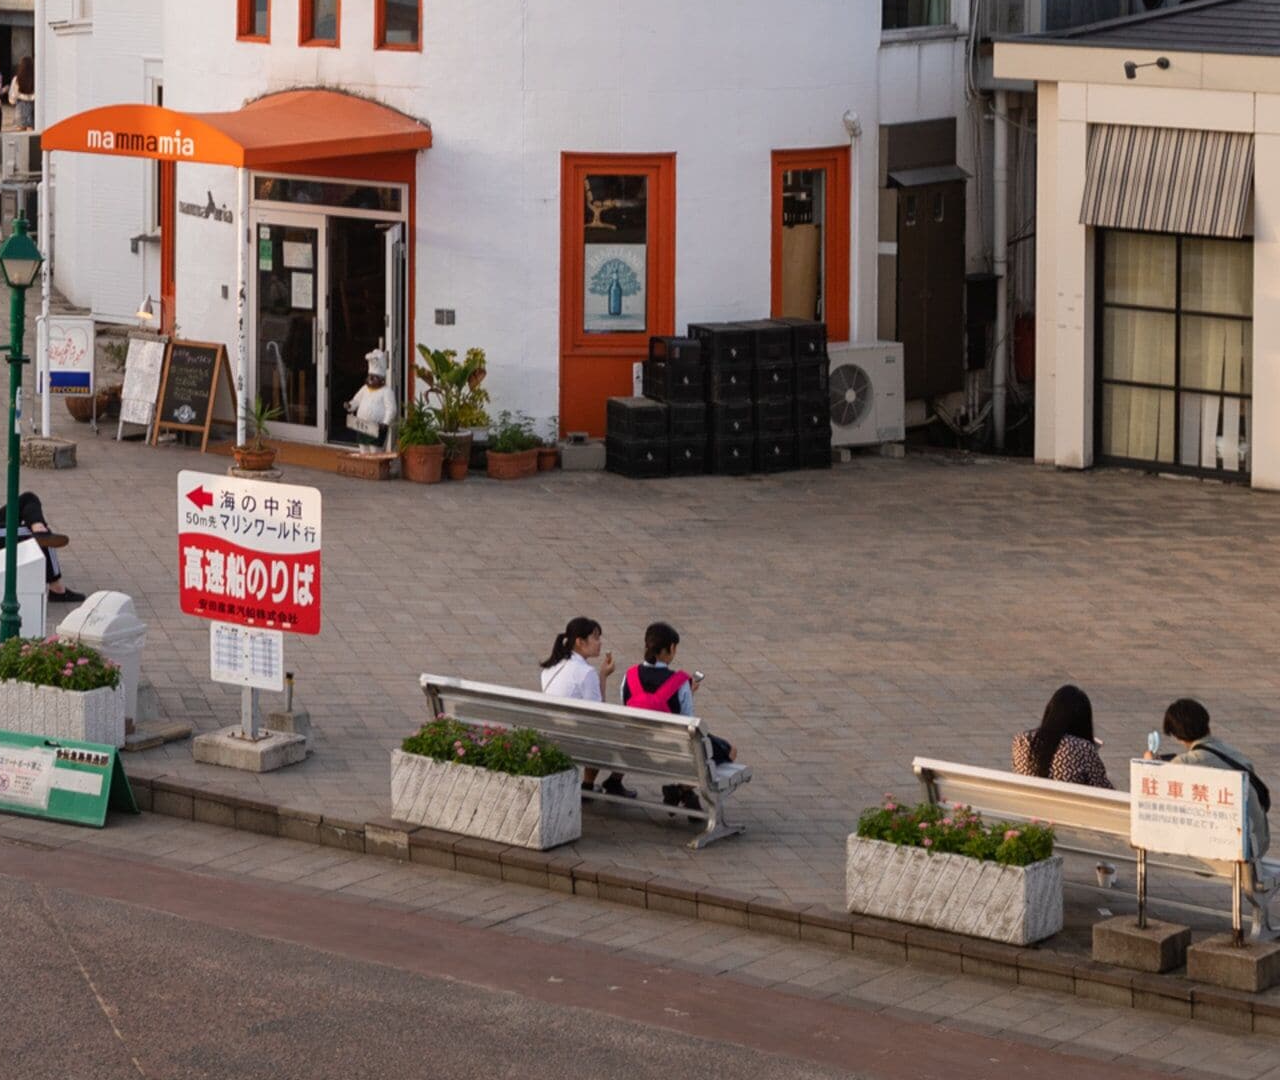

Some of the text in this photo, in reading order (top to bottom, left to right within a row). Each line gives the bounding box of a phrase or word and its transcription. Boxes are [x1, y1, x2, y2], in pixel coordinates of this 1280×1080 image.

[87, 129, 194, 156] mammamia
[220, 489, 303, 520] 海の中道
[185, 512, 217, 529] 50m先
[183, 546, 315, 607] 高速船のりば
[1141, 777, 1234, 805] 駐車禁止
